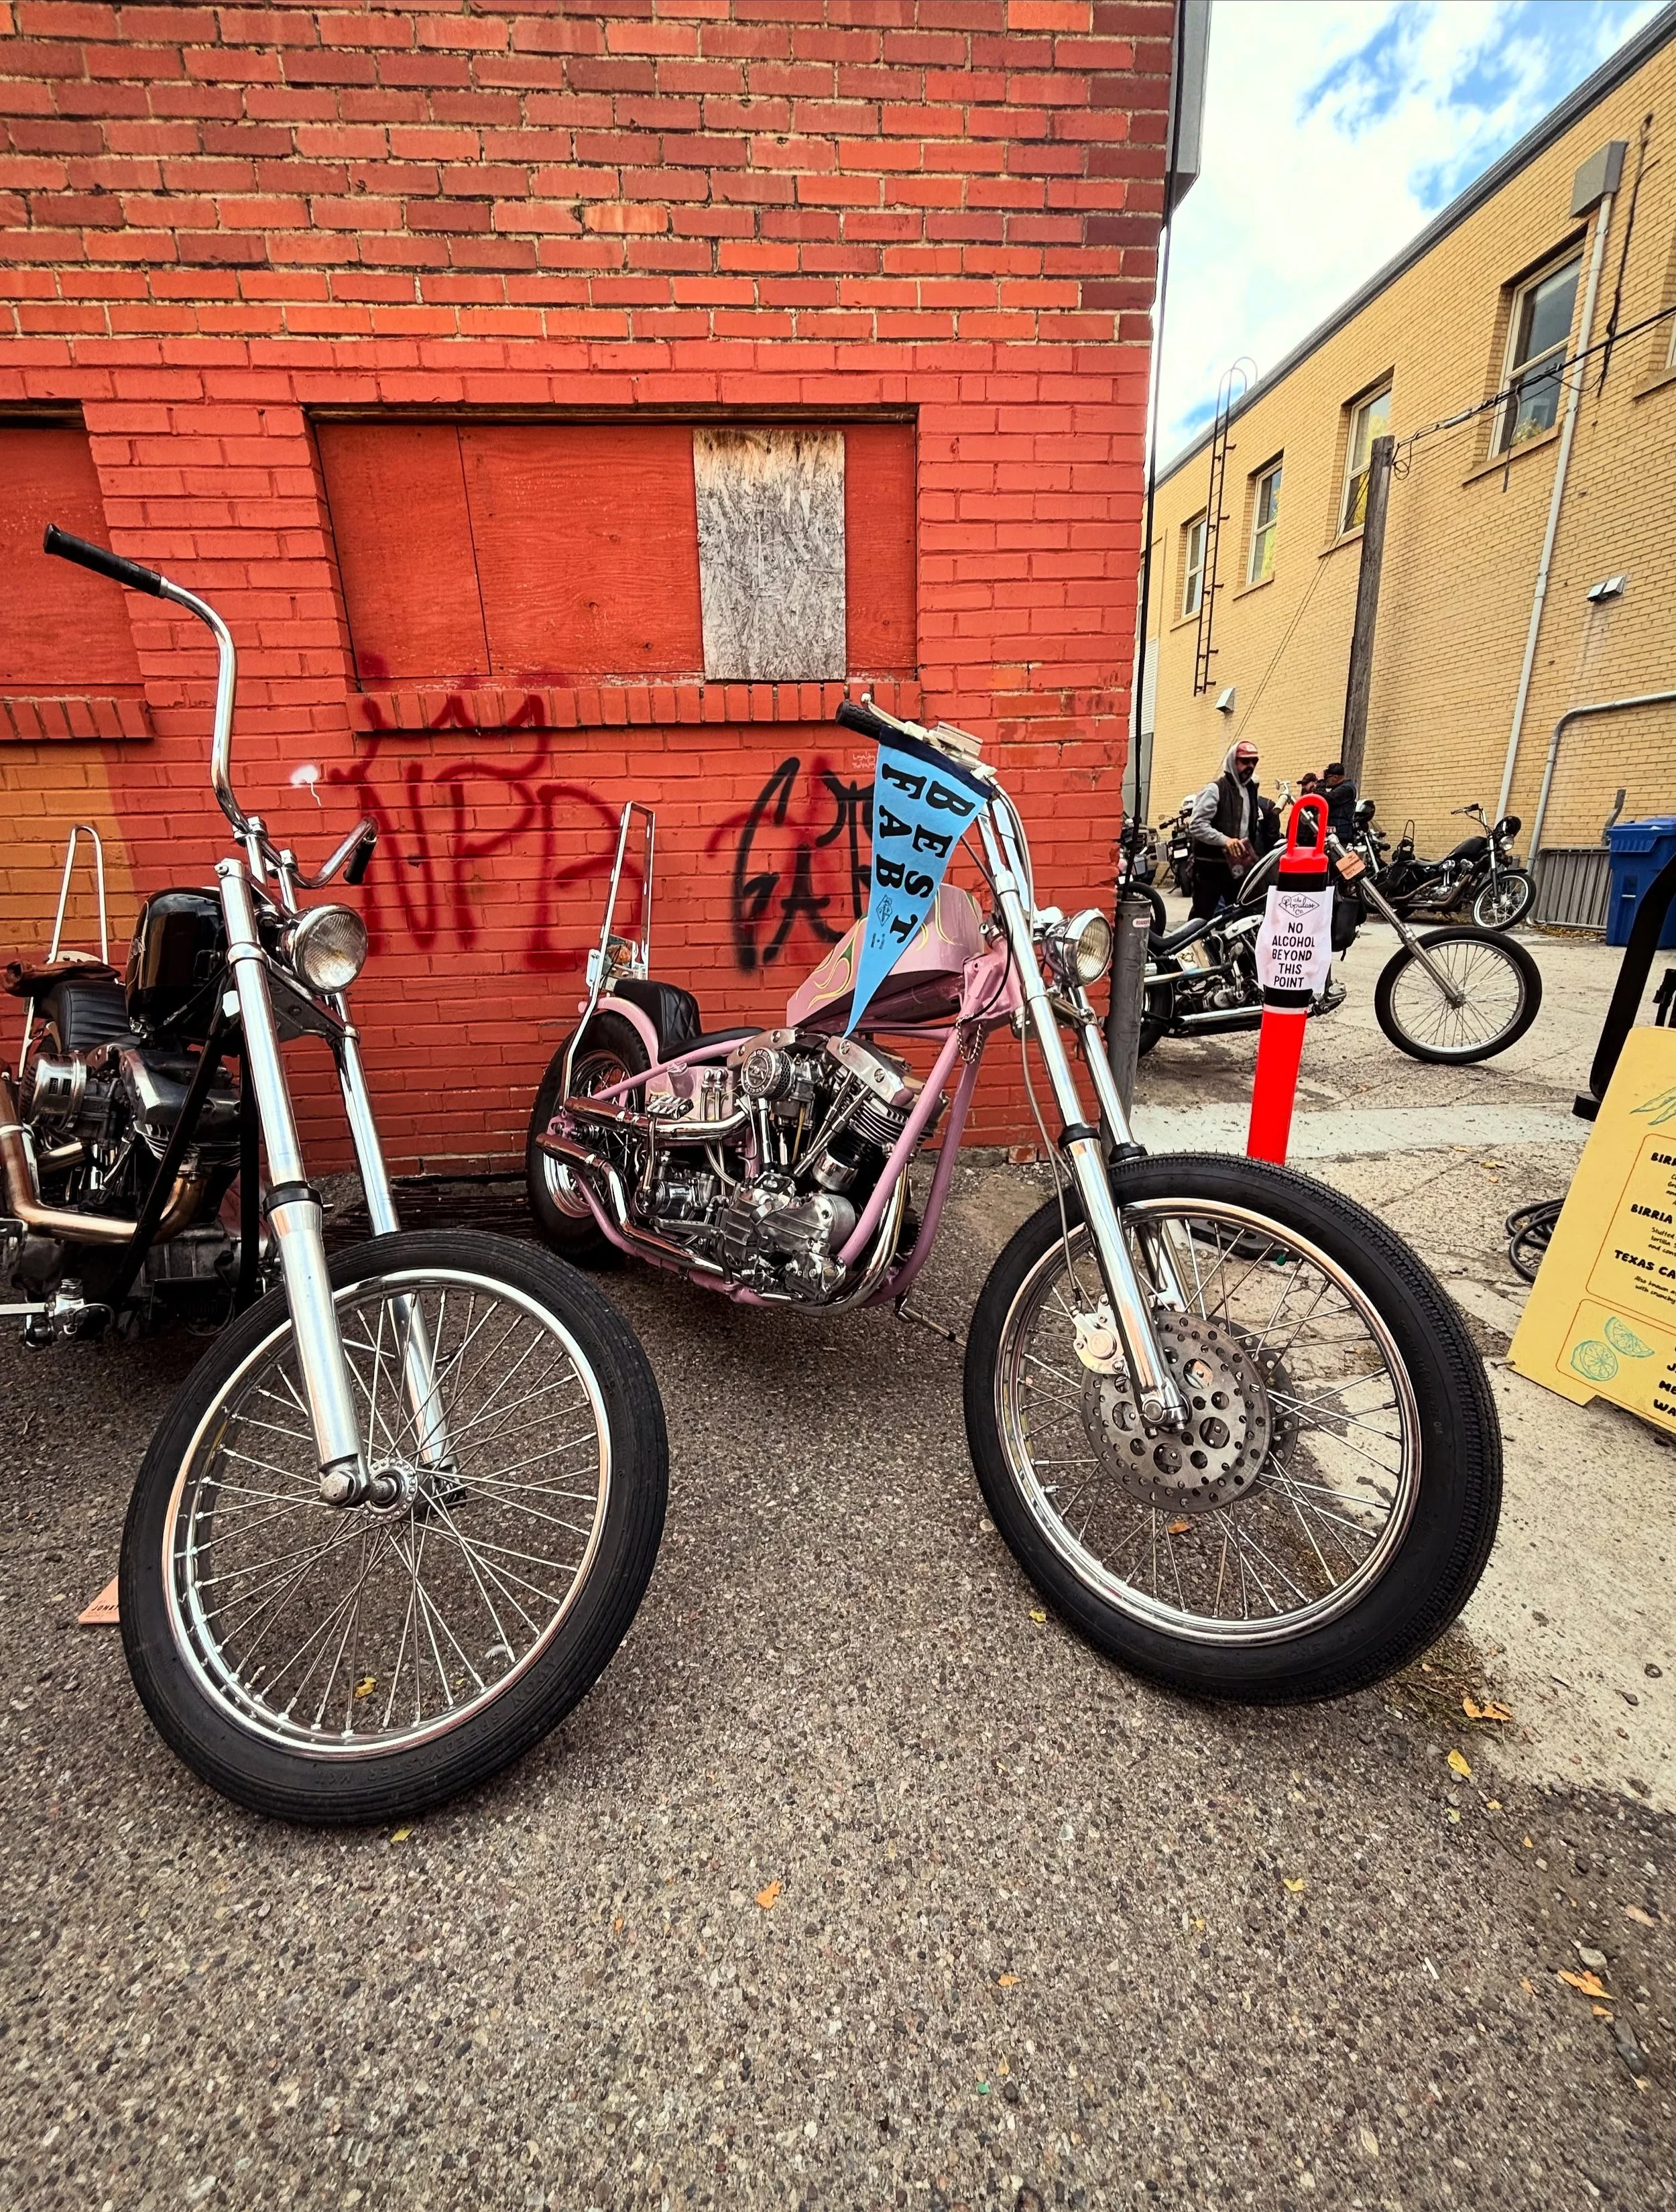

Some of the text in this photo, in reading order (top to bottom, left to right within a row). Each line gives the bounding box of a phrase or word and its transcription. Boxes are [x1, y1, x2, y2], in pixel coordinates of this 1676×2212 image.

[876, 763, 927, 889] FAB
[890, 780, 975, 943] BEST
[1288, 922, 1303, 933] NO
[1272, 935, 1315, 947] ALCOHOL
[1272, 949, 1312, 961] BEYOND
[1278, 963, 1302, 974] THIS
[1274, 976, 1305, 988] POINT
[1630, 1204, 1673, 1224] BIRRIA
[1614, 1249, 1676, 1279] TEXAS CA
[1634, 1275, 1647, 1283] Also
[1650, 1291, 1676, 1305] crunchy
[366, 1710, 502, 1782] SPEEDMASTER
